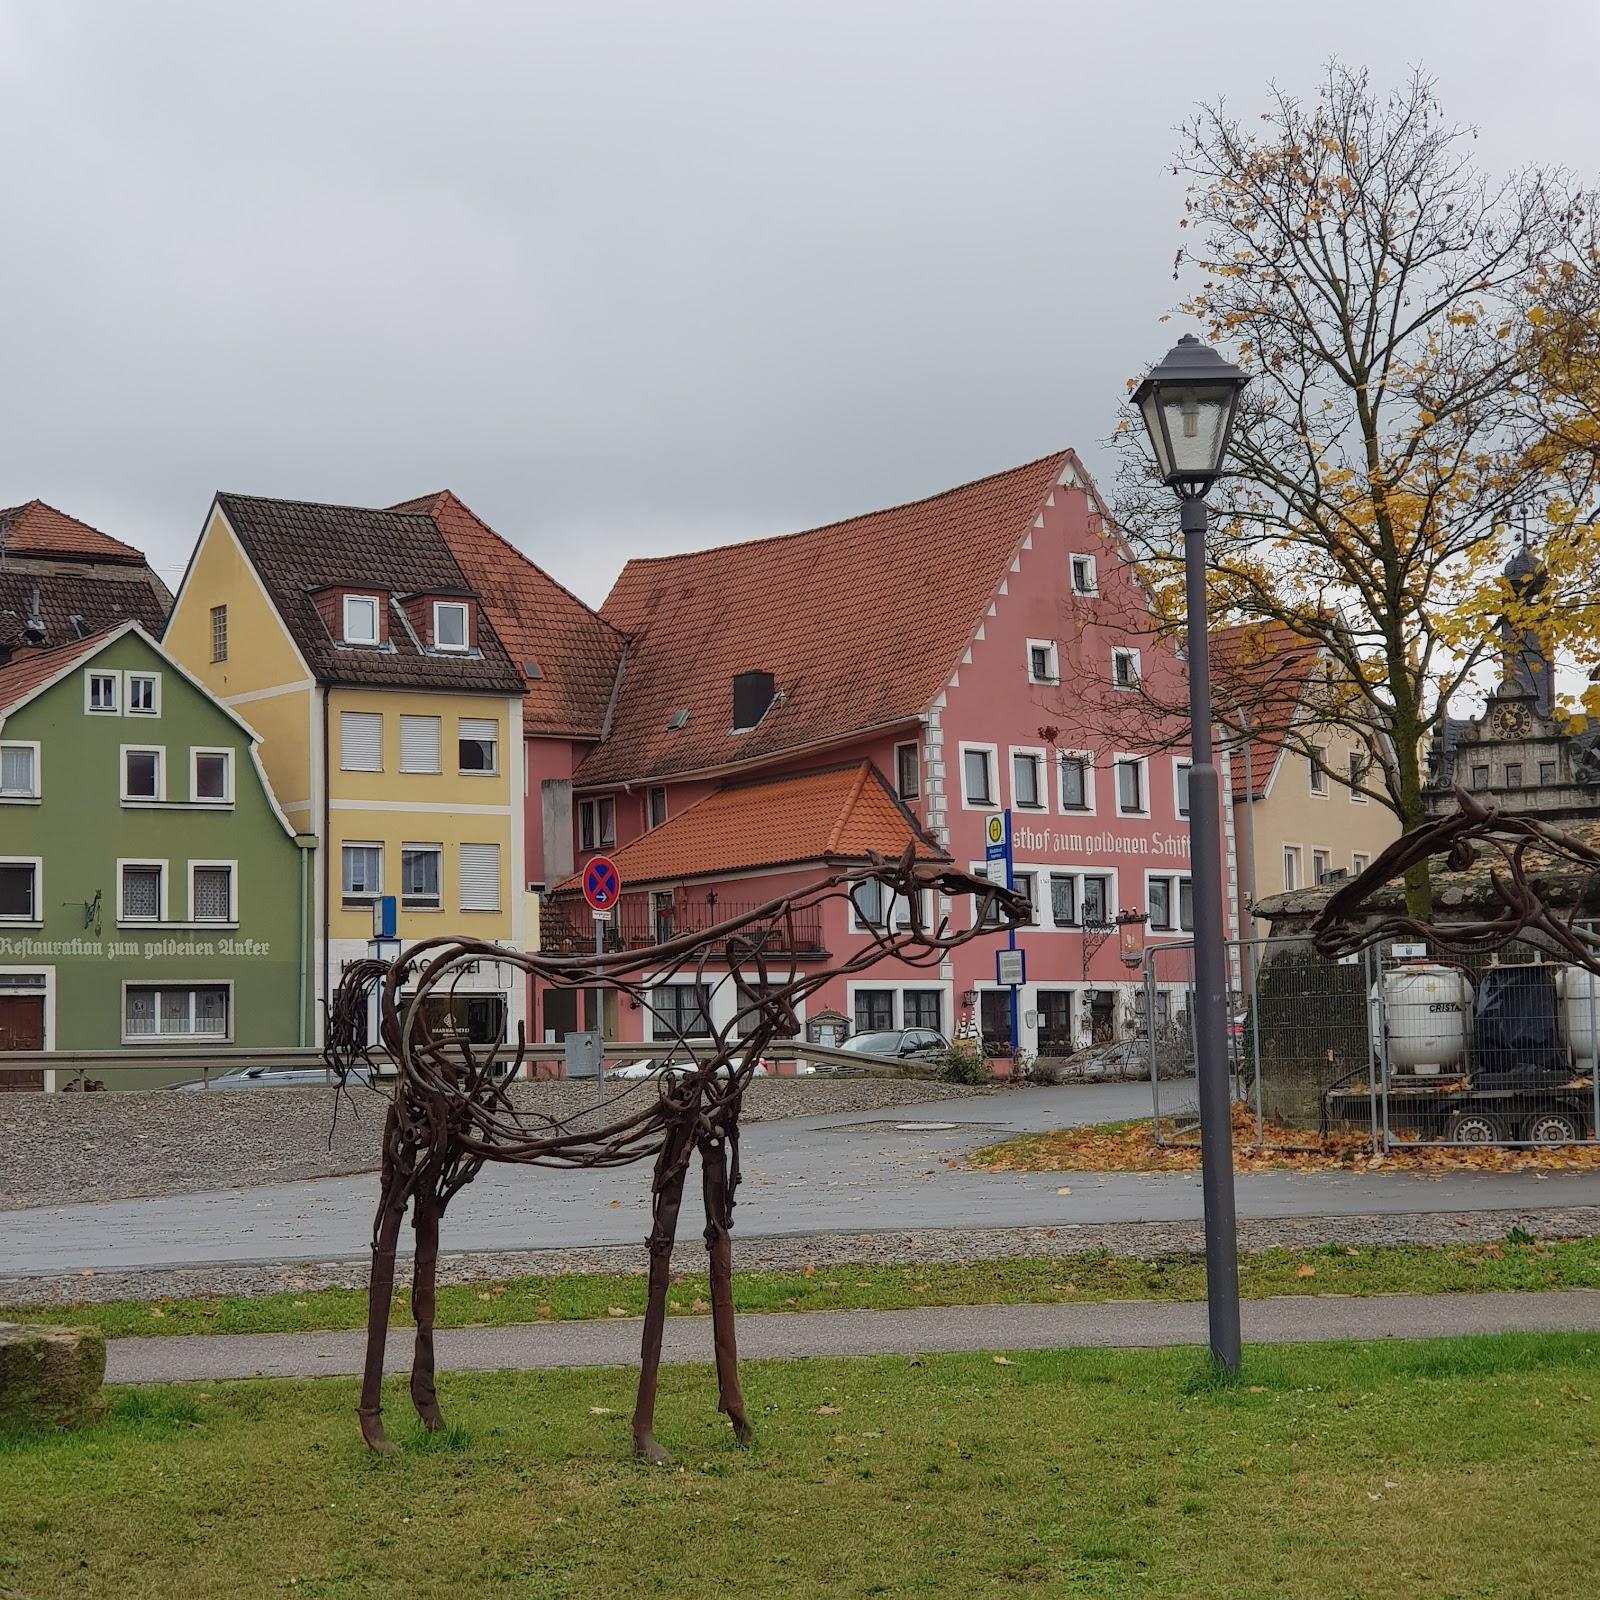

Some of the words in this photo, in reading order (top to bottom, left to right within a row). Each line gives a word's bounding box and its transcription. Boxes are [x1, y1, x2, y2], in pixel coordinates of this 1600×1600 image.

[1013, 827, 1051, 853] sthof
[1053, 832, 1083, 853] zum
[1086, 832, 1149, 856] goldenen
[107, 941, 140, 960] zum
[144, 938, 215, 960] goldenen
[217, 938, 271, 957] Anker
[1429, 1003, 1467, 1013] CRISTA
